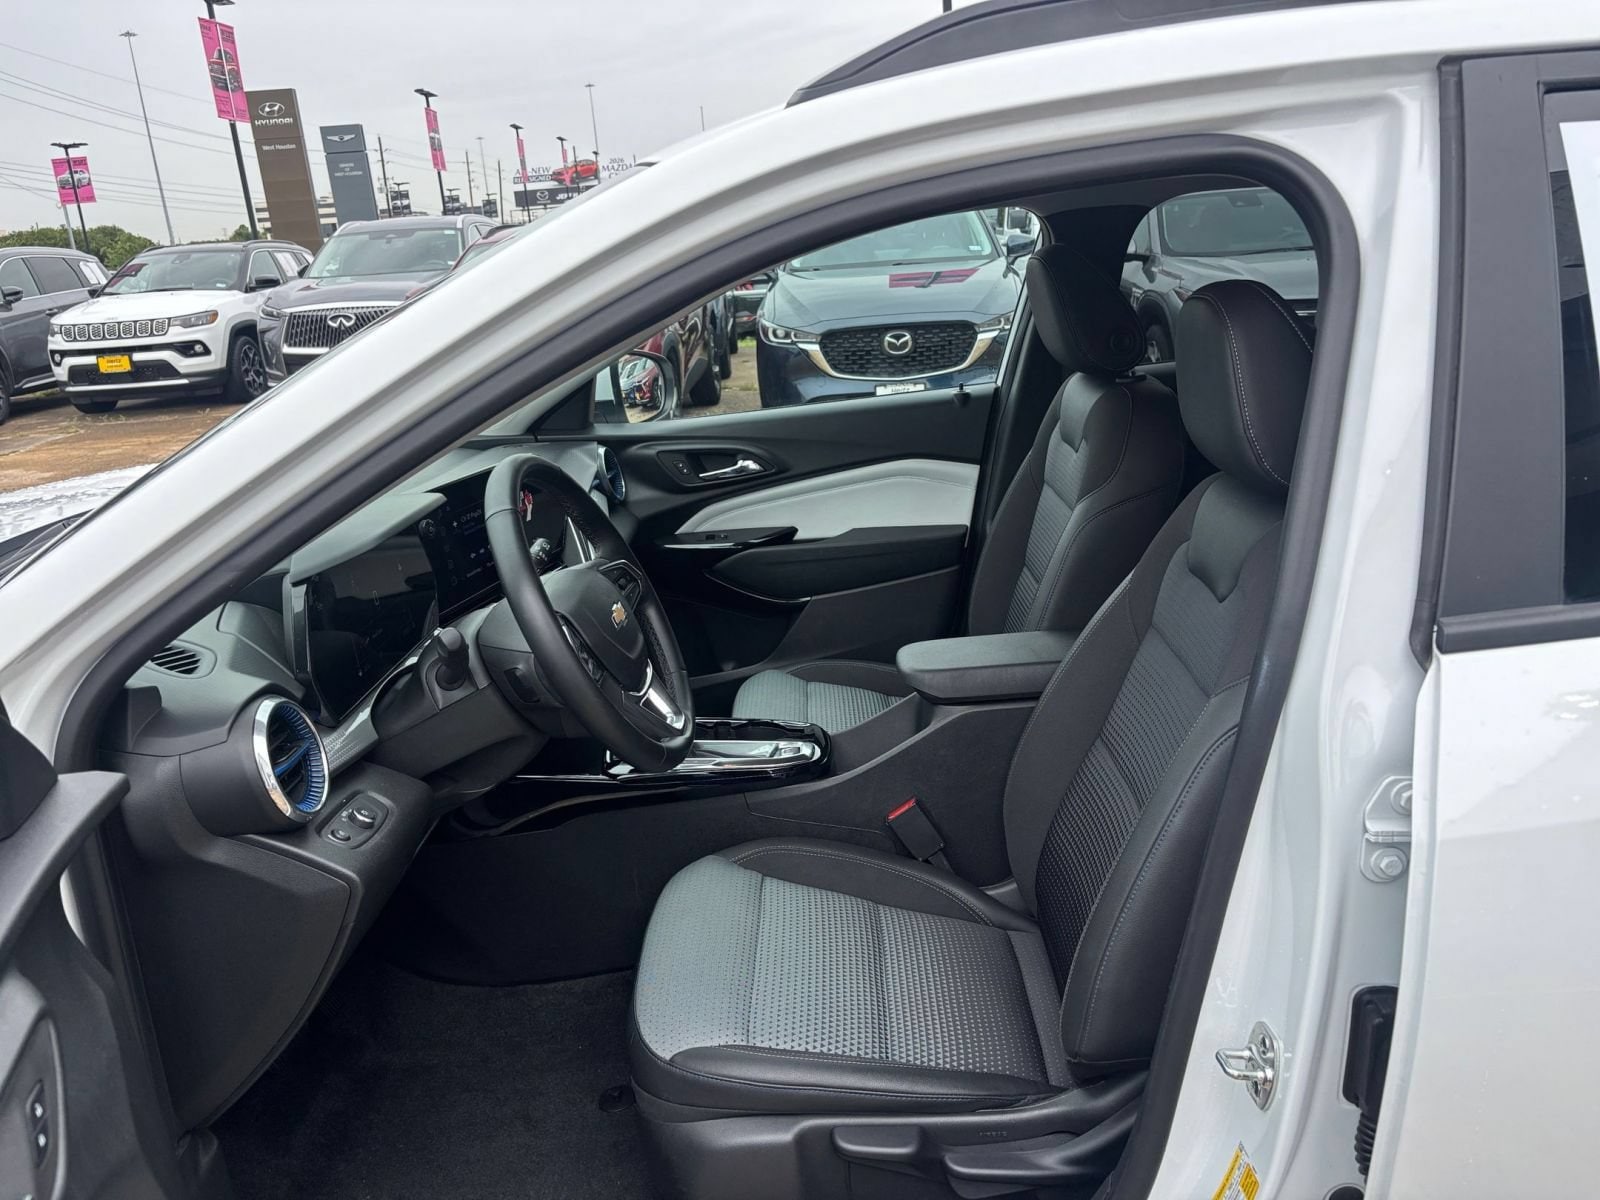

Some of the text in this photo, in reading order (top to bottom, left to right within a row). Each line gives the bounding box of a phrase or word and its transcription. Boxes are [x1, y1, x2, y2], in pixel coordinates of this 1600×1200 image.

[255, 117, 294, 126] HYUNDAI
[515, 166, 551, 175] A-NEW
[602, 163, 632, 172] MAZDA
